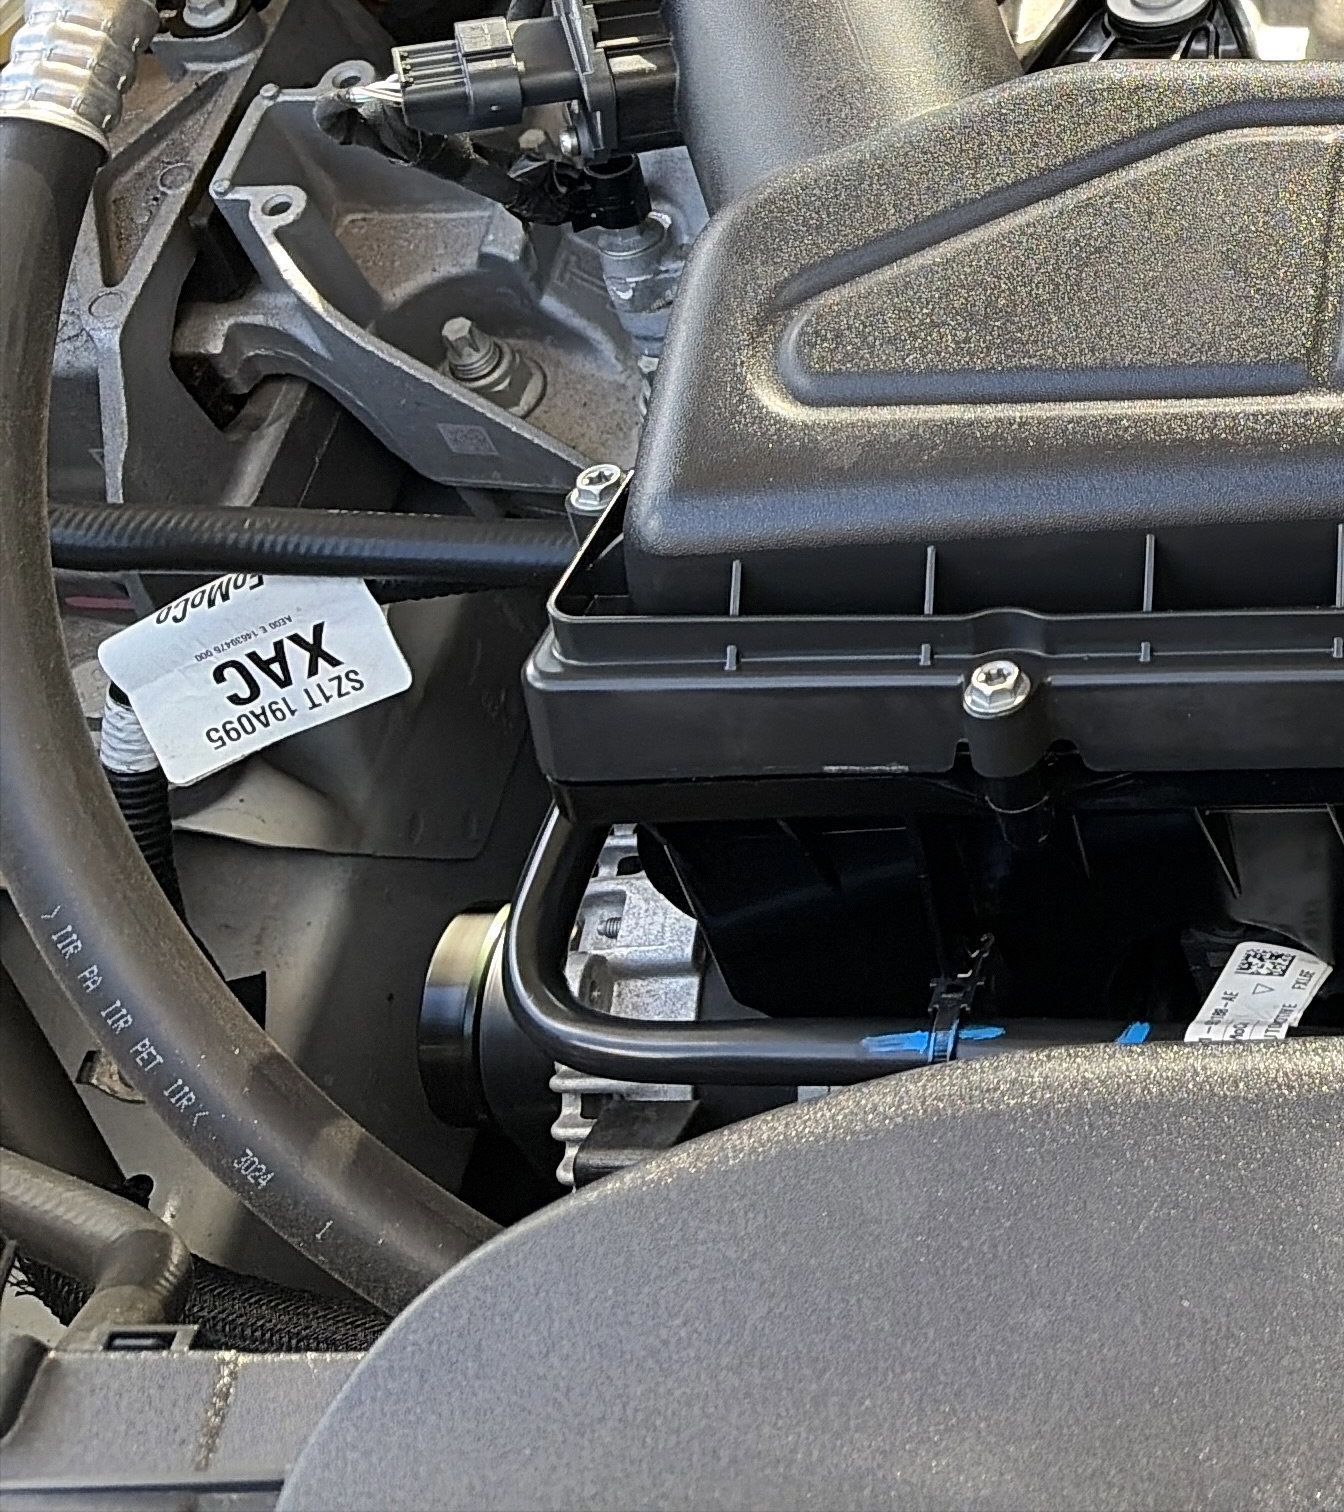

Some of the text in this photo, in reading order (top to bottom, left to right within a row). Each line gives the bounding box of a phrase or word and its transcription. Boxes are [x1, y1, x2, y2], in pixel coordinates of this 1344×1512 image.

[156, 573, 264, 625] FoMoCo
[209, 619, 344, 711] XAC
[203, 666, 364, 751] SZ1T 19A095
[127, 1036, 164, 1074] PET
[231, 1147, 276, 1191] 3024
